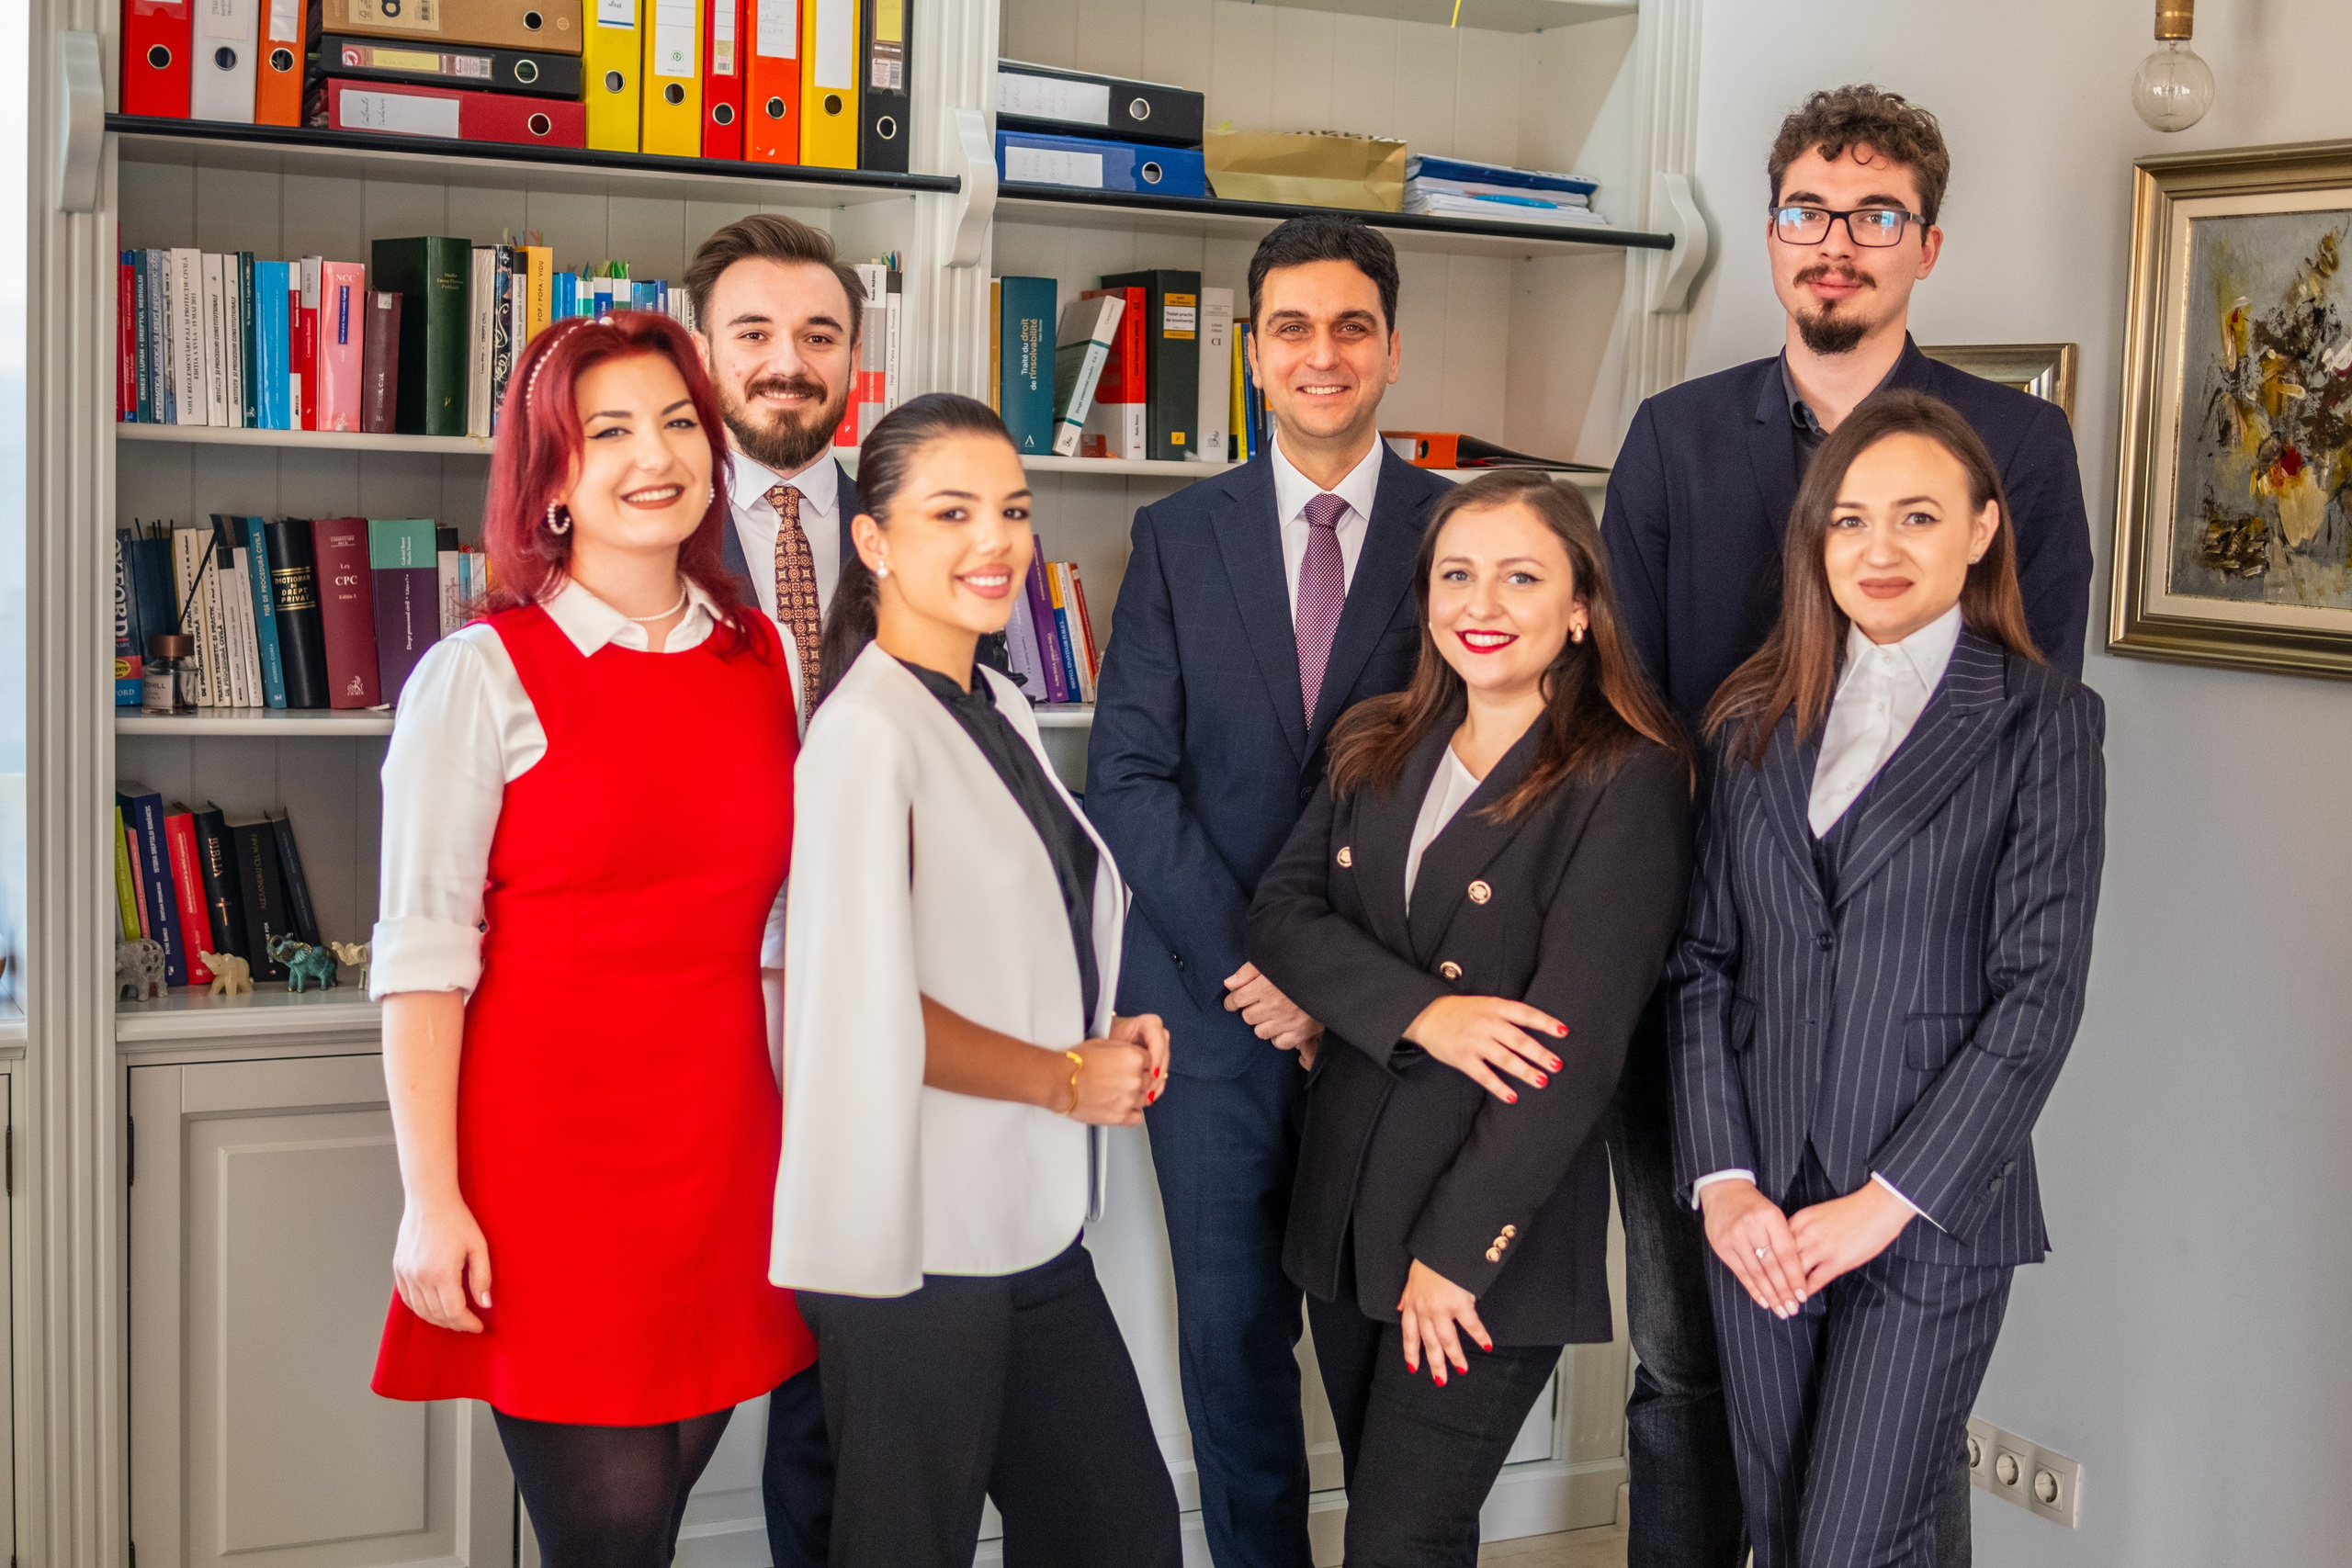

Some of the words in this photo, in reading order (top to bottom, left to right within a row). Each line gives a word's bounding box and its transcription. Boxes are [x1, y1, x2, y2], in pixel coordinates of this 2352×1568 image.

[335, 274, 356, 282] NCC
[1022, 343, 1028, 353] du
[1029, 319, 1037, 379] l'insolvabilité
[1030, 380, 1036, 389] de
[254, 532, 262, 553] CIVILĂ
[256, 554, 267, 592] PROCEDURĂ
[335, 575, 357, 586] CPC
[282, 587, 307, 595] DREPT
[263, 594, 268, 603] DE
[194, 619, 202, 641] CIVILĂ
[197, 643, 206, 685] PROCEDURĂ
[200, 687, 207, 696] DE
[209, 837, 223, 877] BIBLIA
